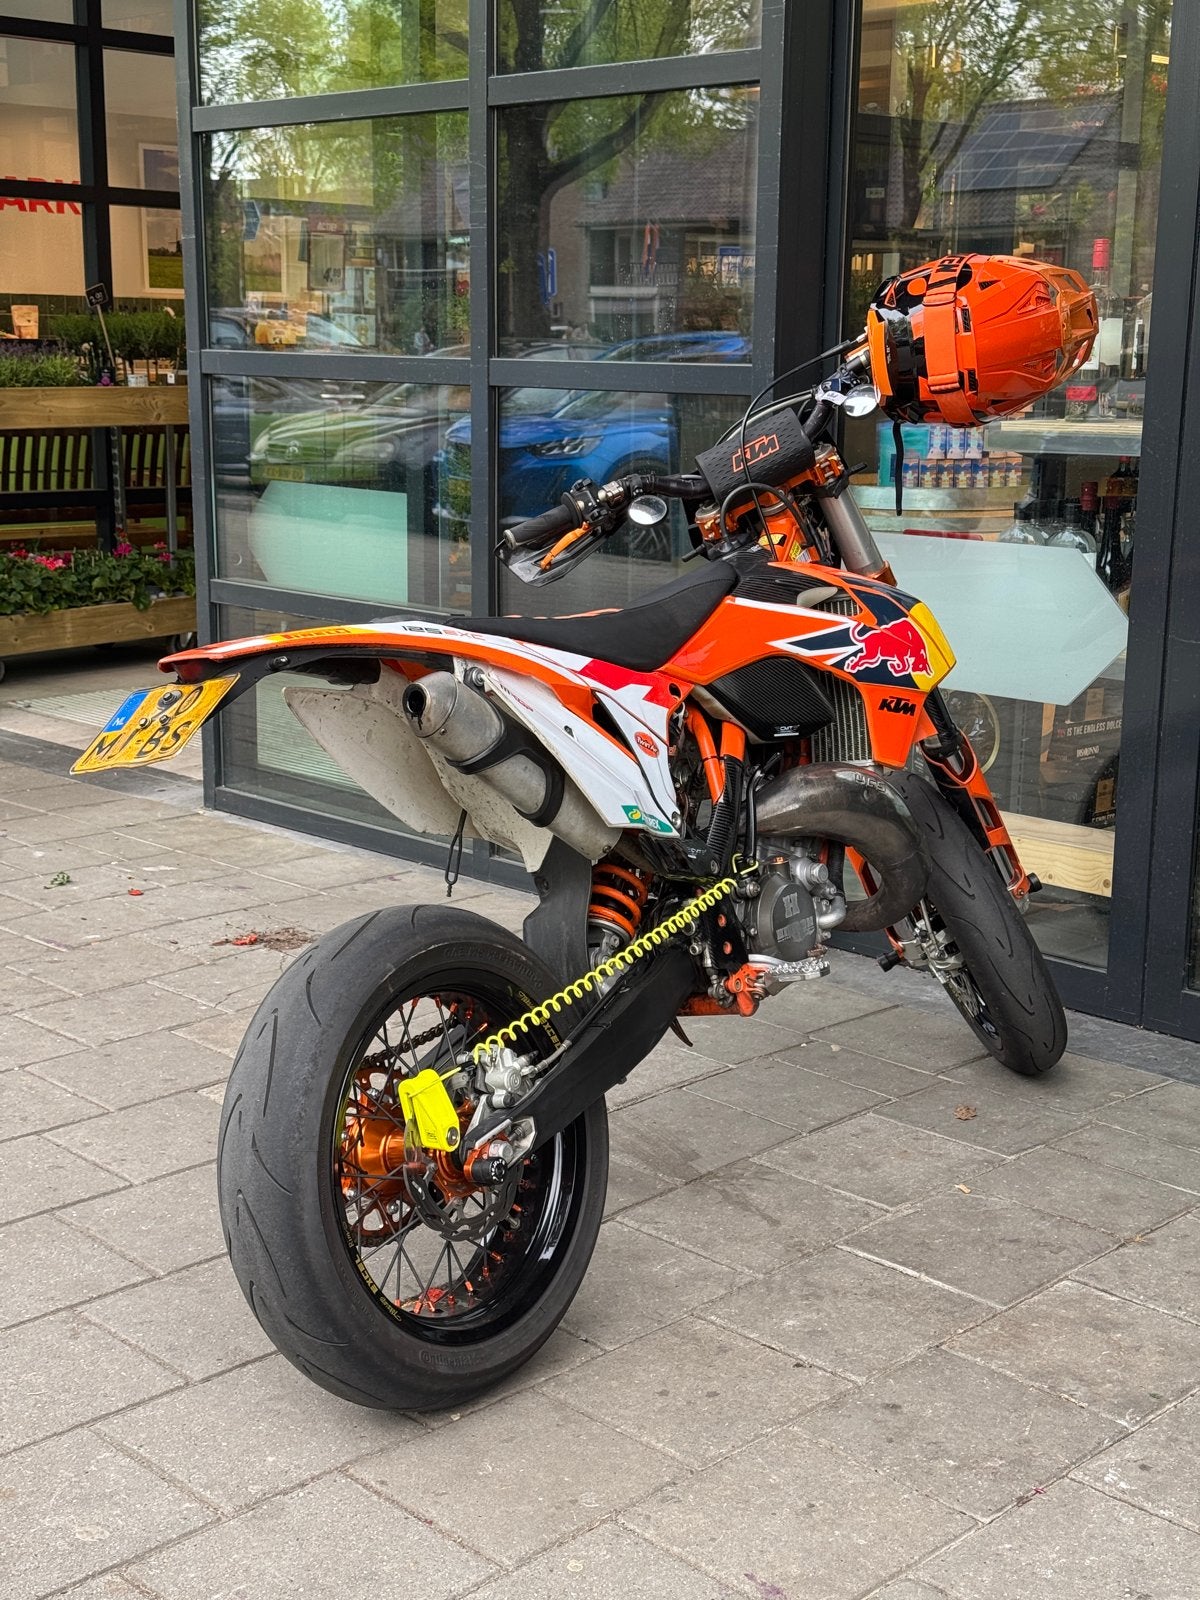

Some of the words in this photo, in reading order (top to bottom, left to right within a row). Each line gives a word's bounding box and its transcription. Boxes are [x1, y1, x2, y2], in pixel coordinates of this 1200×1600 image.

[732, 433, 780, 473] KTM
[112, 716, 126, 726] NL
[878, 695, 917, 717] KTM
[354, 1254, 379, 1295] EXCEL
